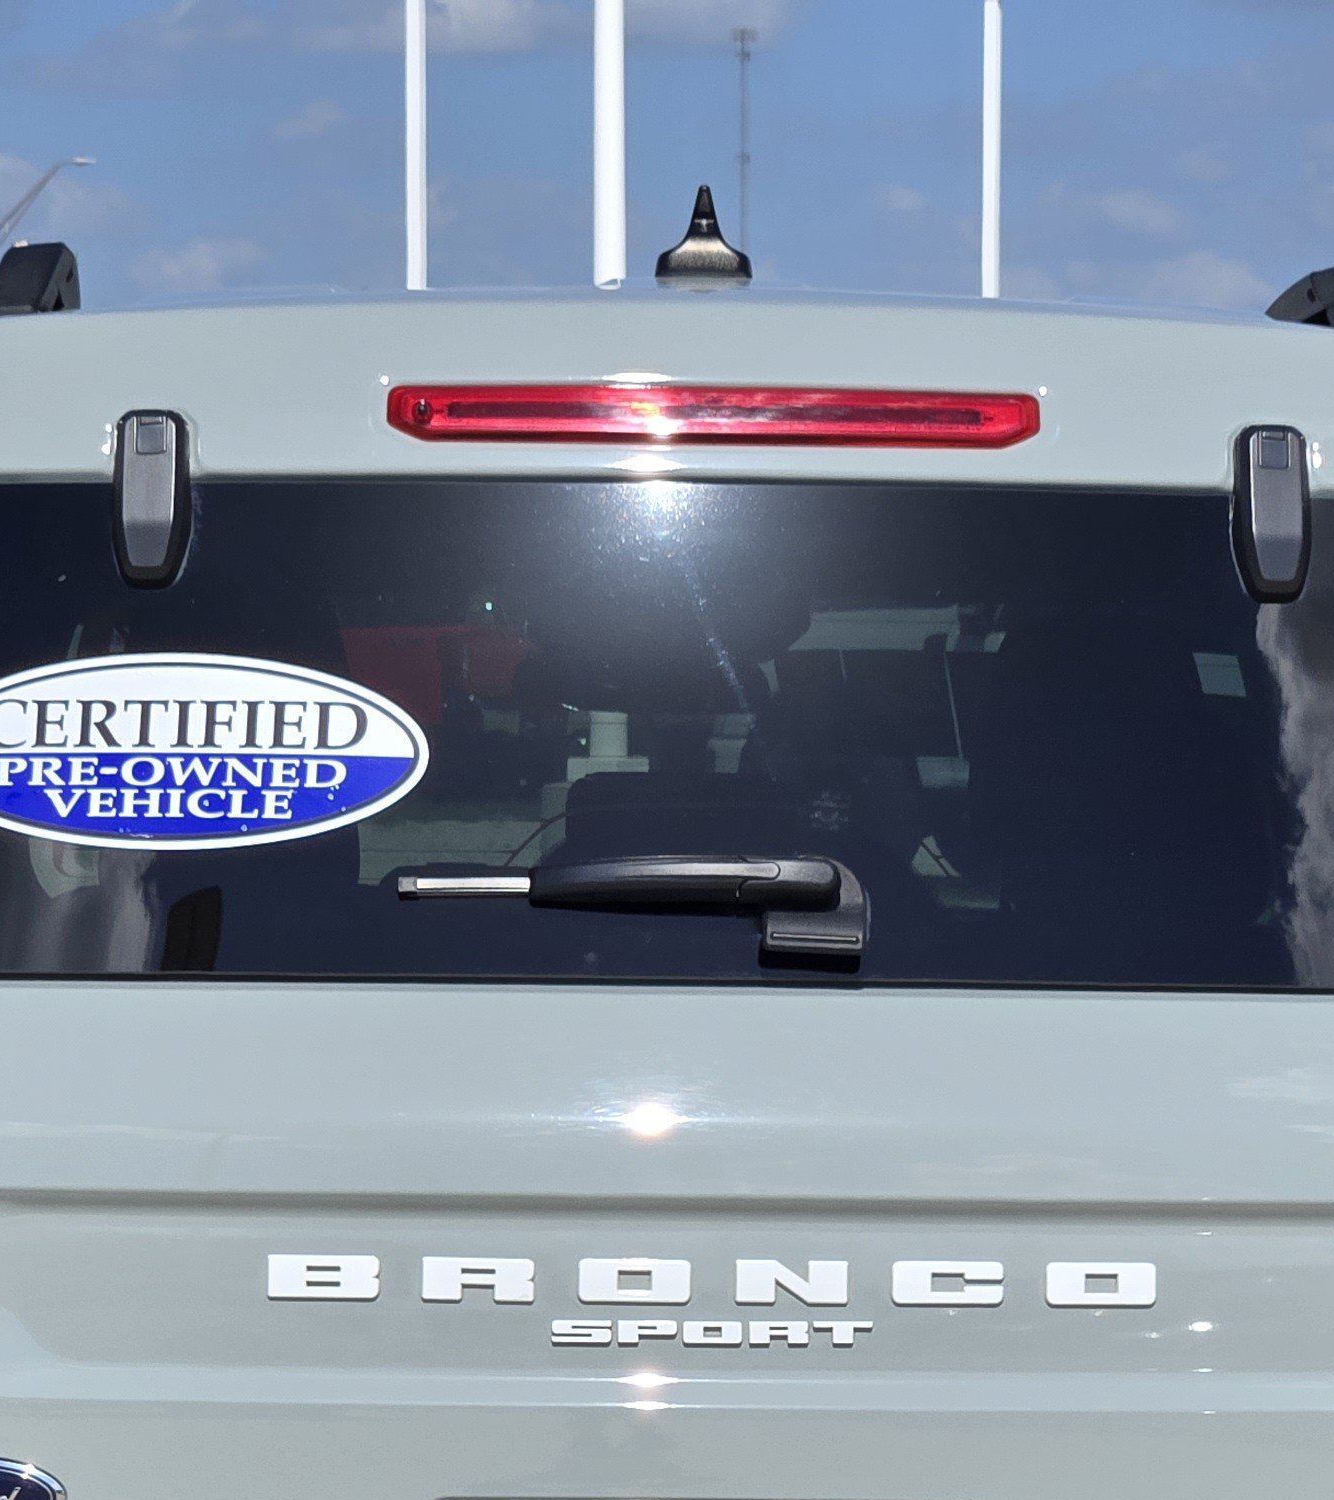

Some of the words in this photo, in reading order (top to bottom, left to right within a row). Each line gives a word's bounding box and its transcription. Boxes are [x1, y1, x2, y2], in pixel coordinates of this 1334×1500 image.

[44, 788, 293, 819] VEHICLE
[267, 1253, 1157, 1306] BRONCO
[550, 1319, 873, 1347] SPORT
